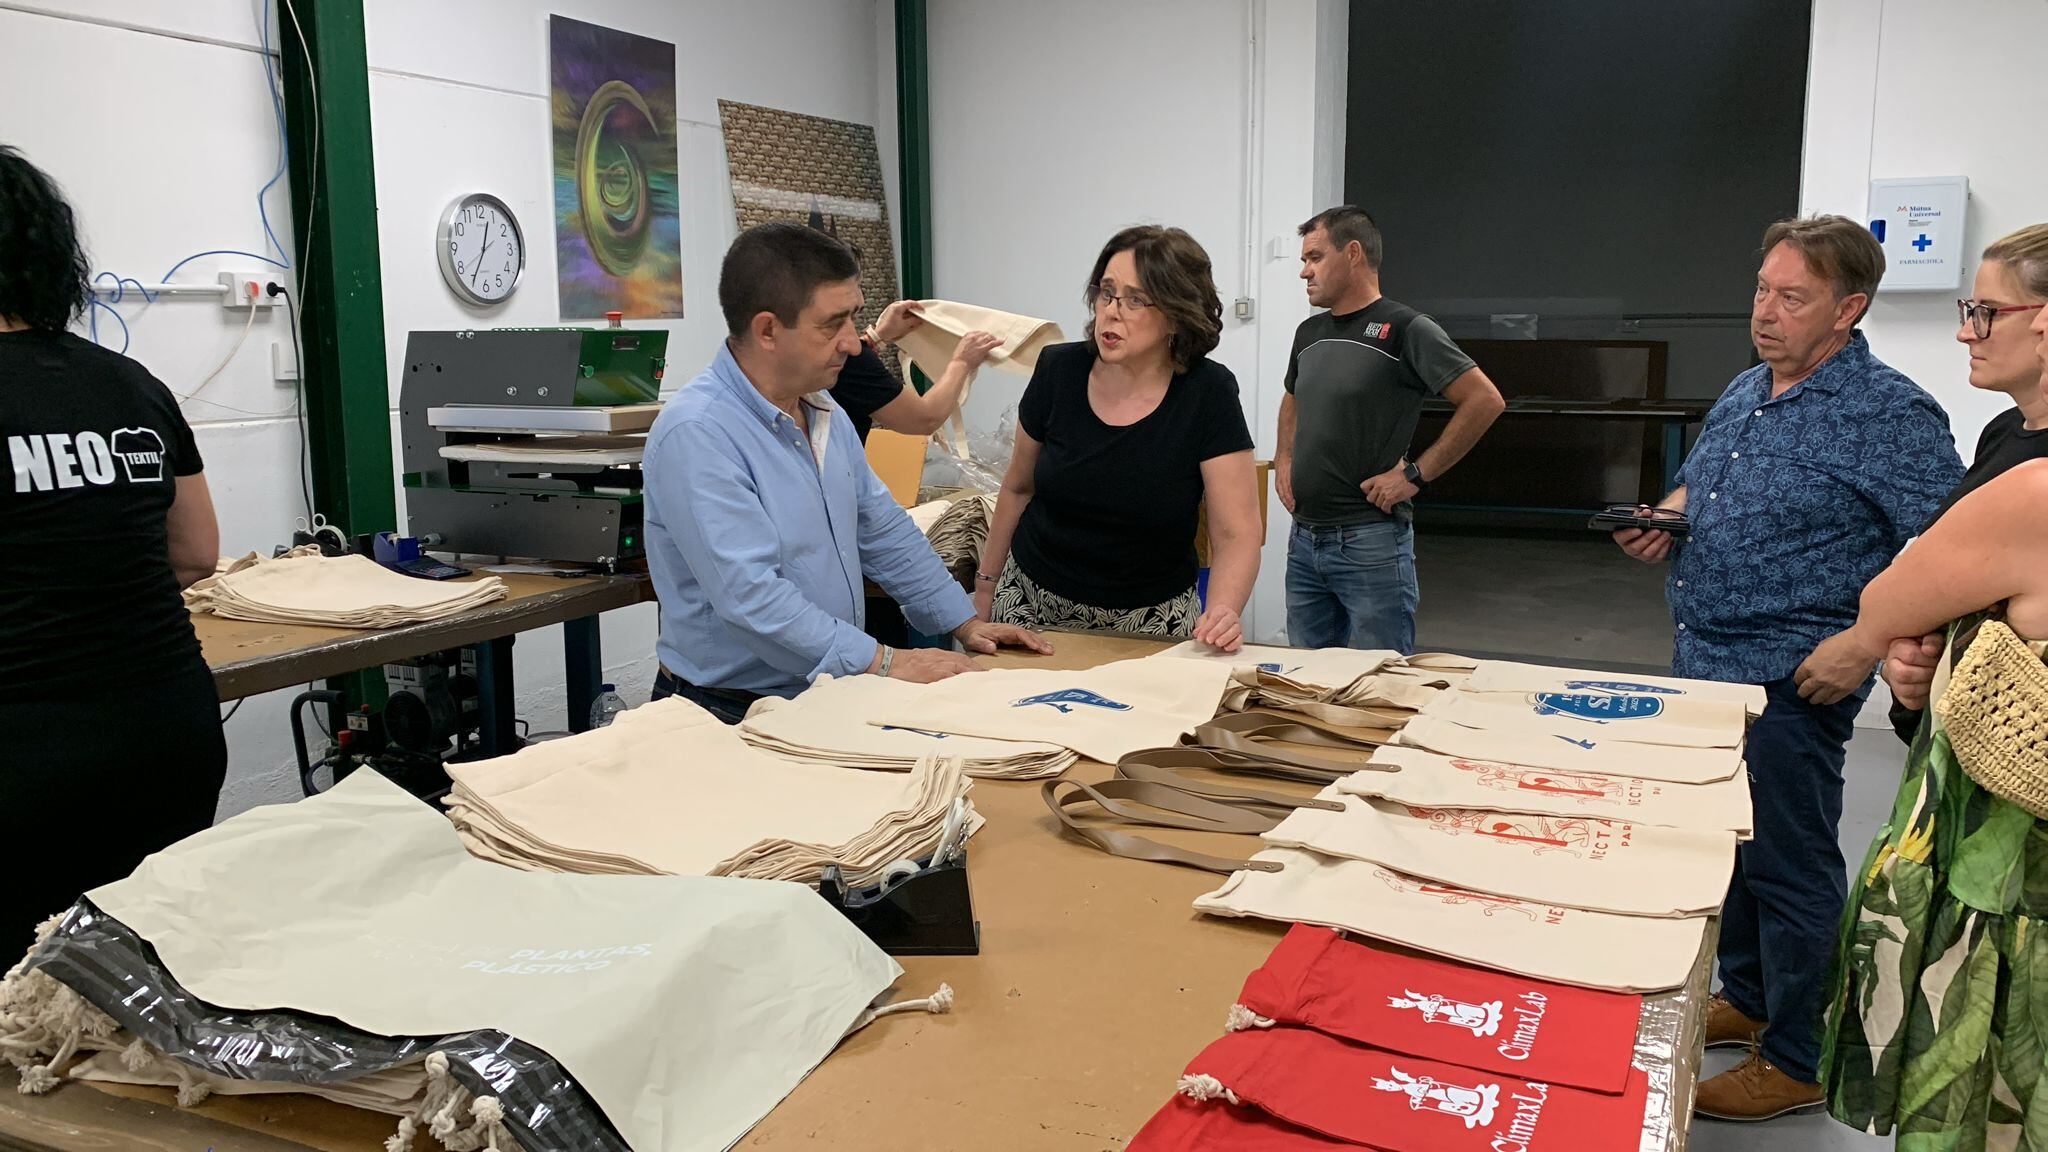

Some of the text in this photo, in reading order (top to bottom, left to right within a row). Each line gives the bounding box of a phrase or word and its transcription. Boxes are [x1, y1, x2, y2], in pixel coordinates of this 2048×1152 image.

[462, 209, 472, 223] 11
[473, 204, 485, 219] 12
[490, 210, 495, 224] 1
[454, 222, 465, 237] 10
[500, 223, 507, 237] 2
[450, 241, 458, 256] 9
[506, 242, 513, 256] 3
[457, 260, 465, 275] 8
[504, 260, 511, 274] 4
[482, 279, 490, 293] 6
[495, 274, 503, 288] 5
[7, 430, 117, 493] NEO
[126, 451, 160, 465] TEXTIL
[1589, 819, 1613, 861] NECTA
[1496, 991, 1549, 1061] ClimaxLab
[1490, 1081, 1550, 1152] ClimaxLa
